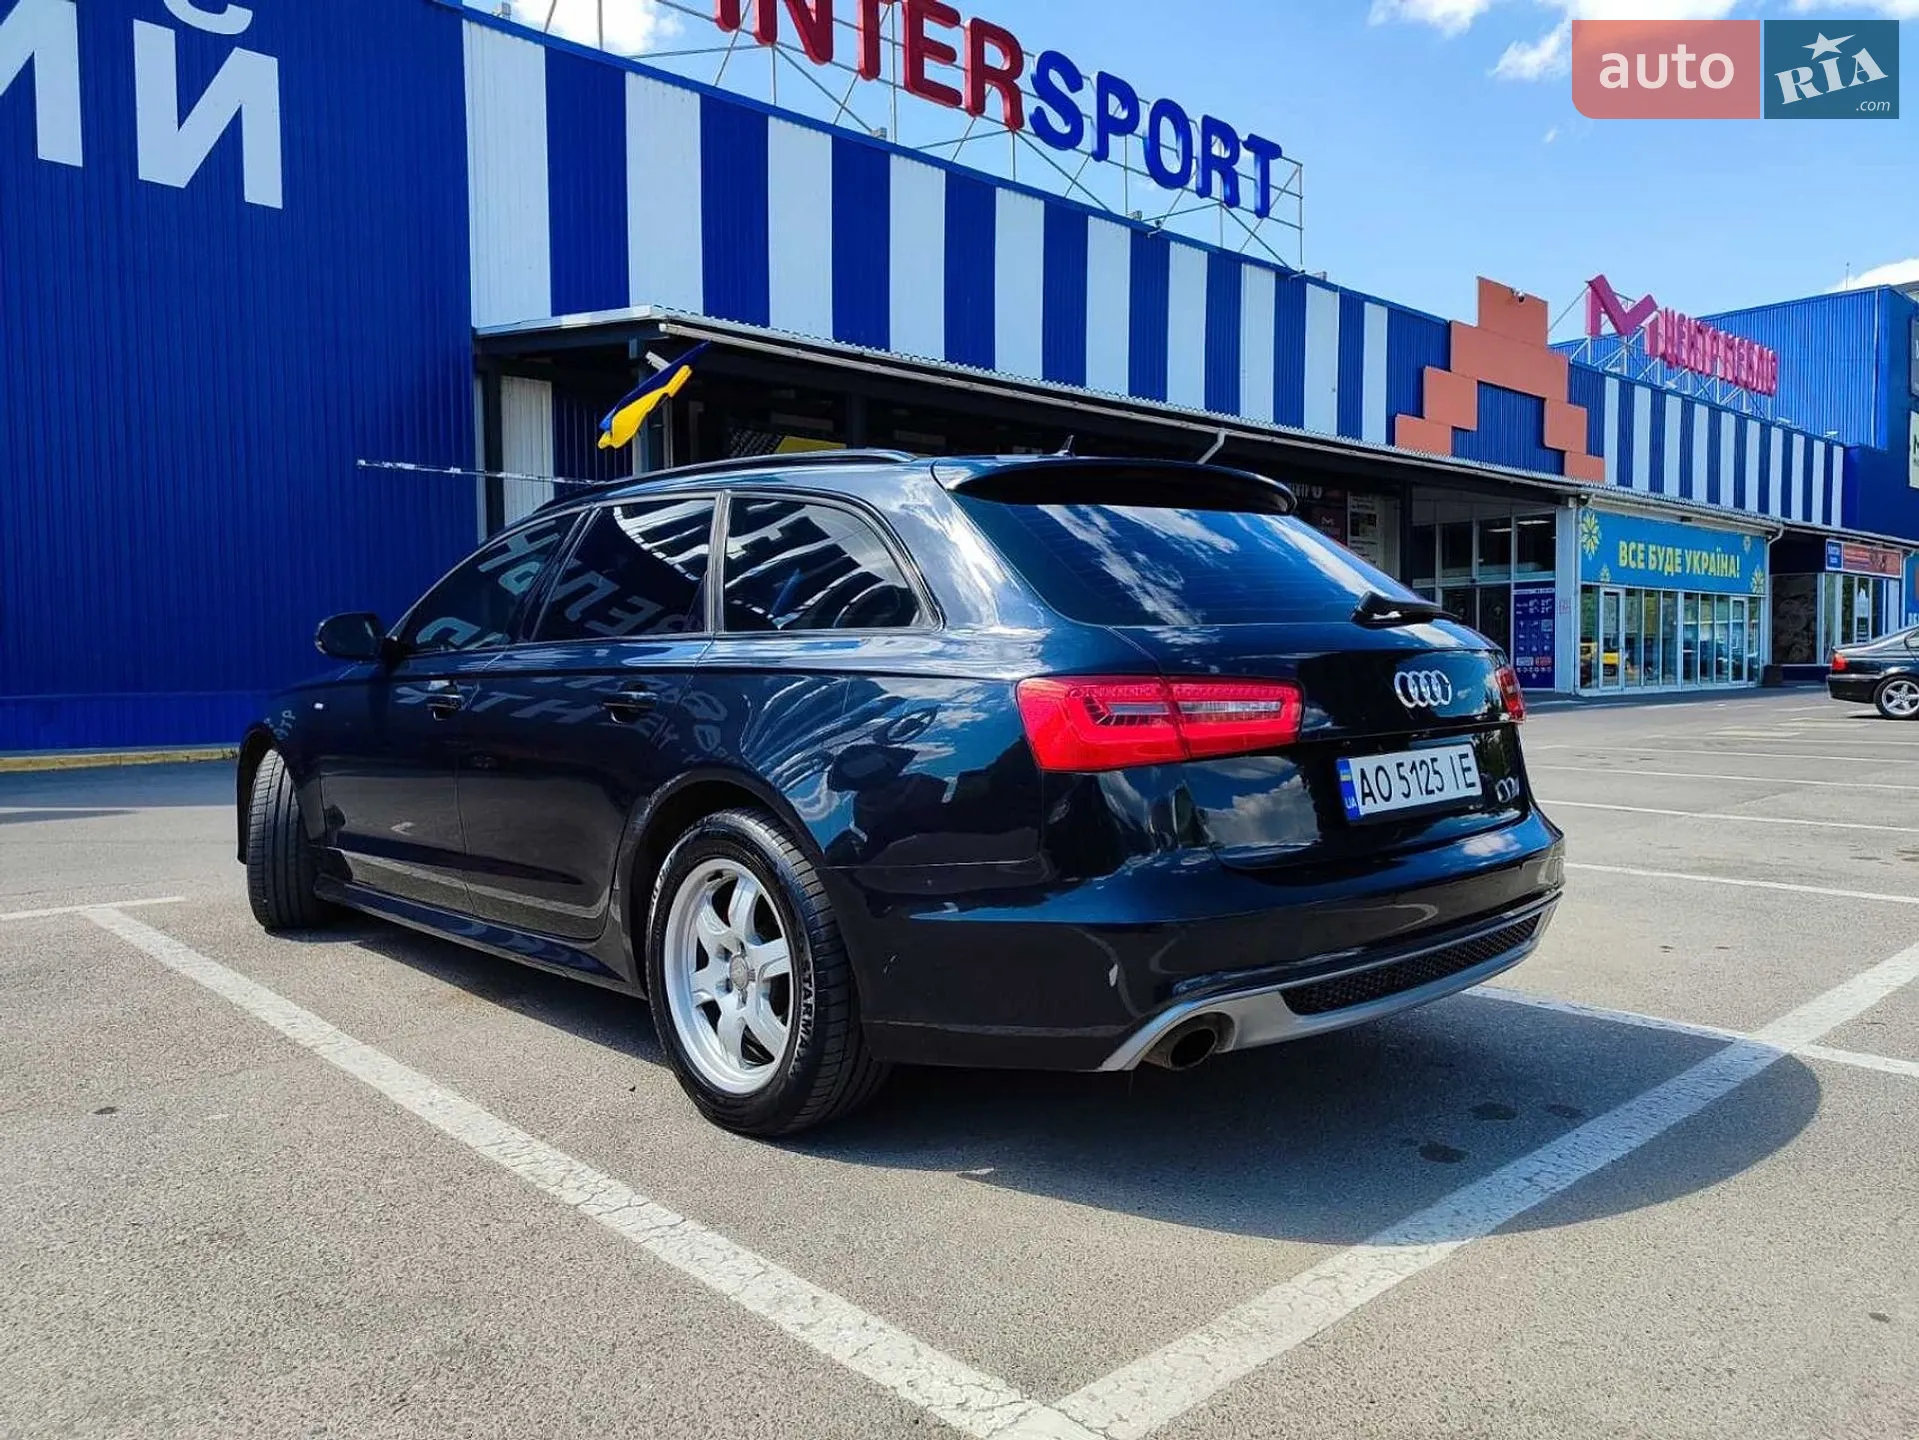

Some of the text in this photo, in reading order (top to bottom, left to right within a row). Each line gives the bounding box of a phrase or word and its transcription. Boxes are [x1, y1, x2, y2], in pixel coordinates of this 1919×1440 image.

[1618, 540, 1741, 579] ВСЕ БУДЕ УКРАЇНА!
[1344, 752, 1477, 810] UA AO 5125 IE
[788, 960, 815, 1077] STARMA
